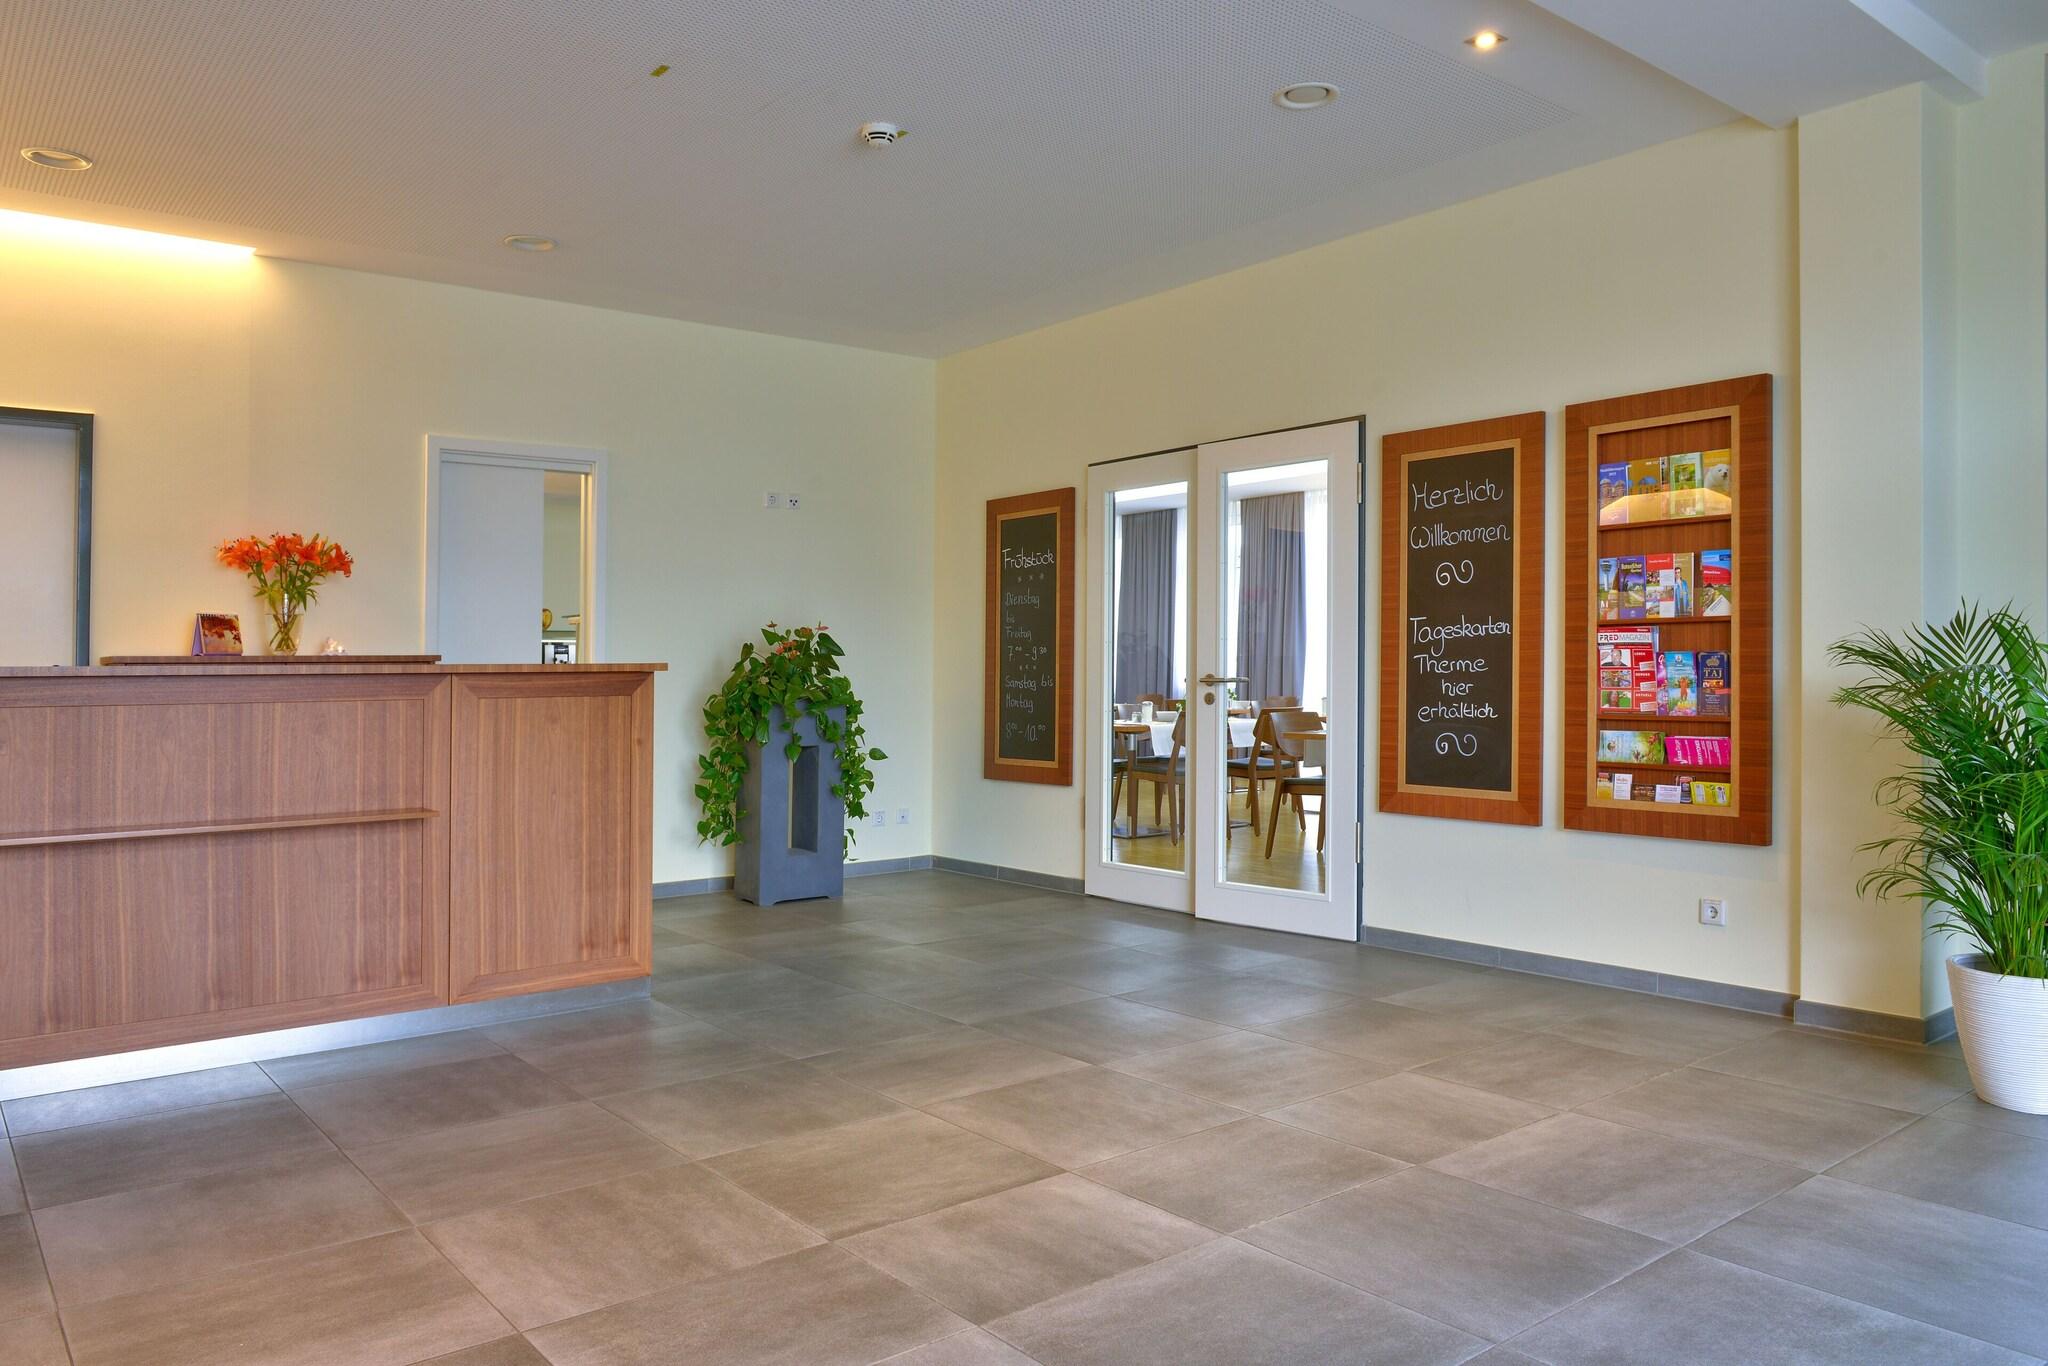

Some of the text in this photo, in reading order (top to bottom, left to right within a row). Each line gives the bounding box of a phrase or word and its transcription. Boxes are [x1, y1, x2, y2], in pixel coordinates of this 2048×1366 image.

[1411, 478, 1504, 512] Herzlich
[1410, 522, 1511, 549] Willkommen
[1001, 546, 1055, 569] Frühstück
[1005, 587, 1040, 609] Dienstag
[1005, 625, 1032, 641] Freitag
[1409, 614, 1512, 657] Tageskarten
[1413, 654, 1489, 675] Therme
[1703, 669, 1723, 678] TAJ
[1005, 674, 1054, 691] Samstag bis
[1441, 678, 1474, 697] hier
[1005, 692, 1034, 713] Montag
[1417, 701, 1499, 723] erhältlich
